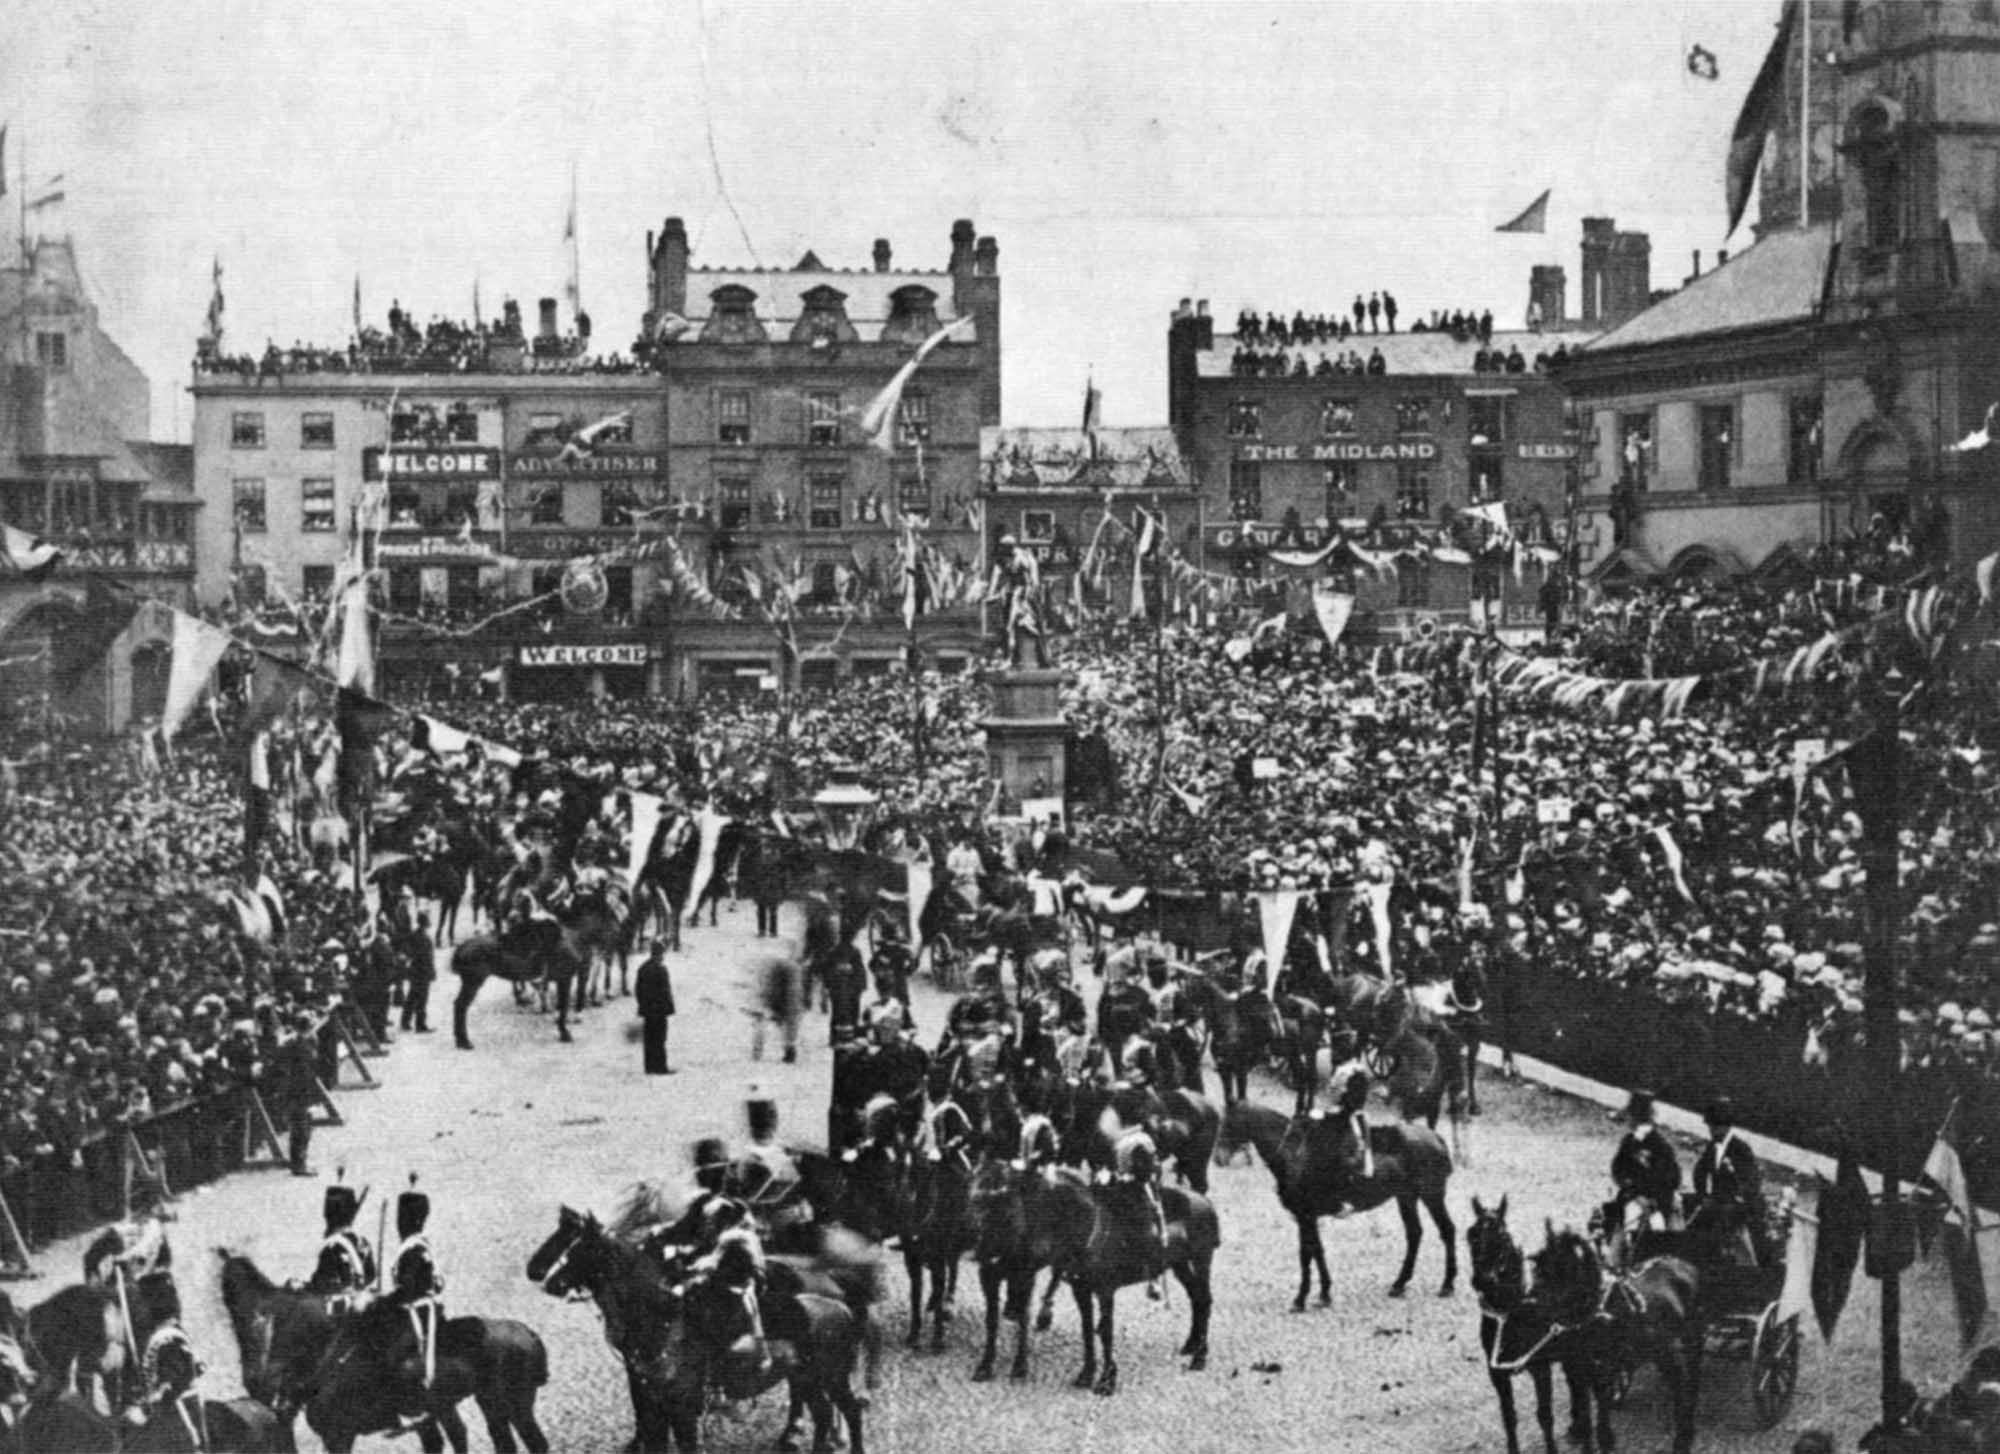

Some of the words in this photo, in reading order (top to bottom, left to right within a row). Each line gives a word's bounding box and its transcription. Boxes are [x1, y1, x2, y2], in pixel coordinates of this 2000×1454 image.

[1244, 444, 1299, 460] THE
[1313, 443, 1435, 460] MIDLAND
[377, 453, 489, 473] WELCOME
[526, 645, 648, 664] WELCOME
